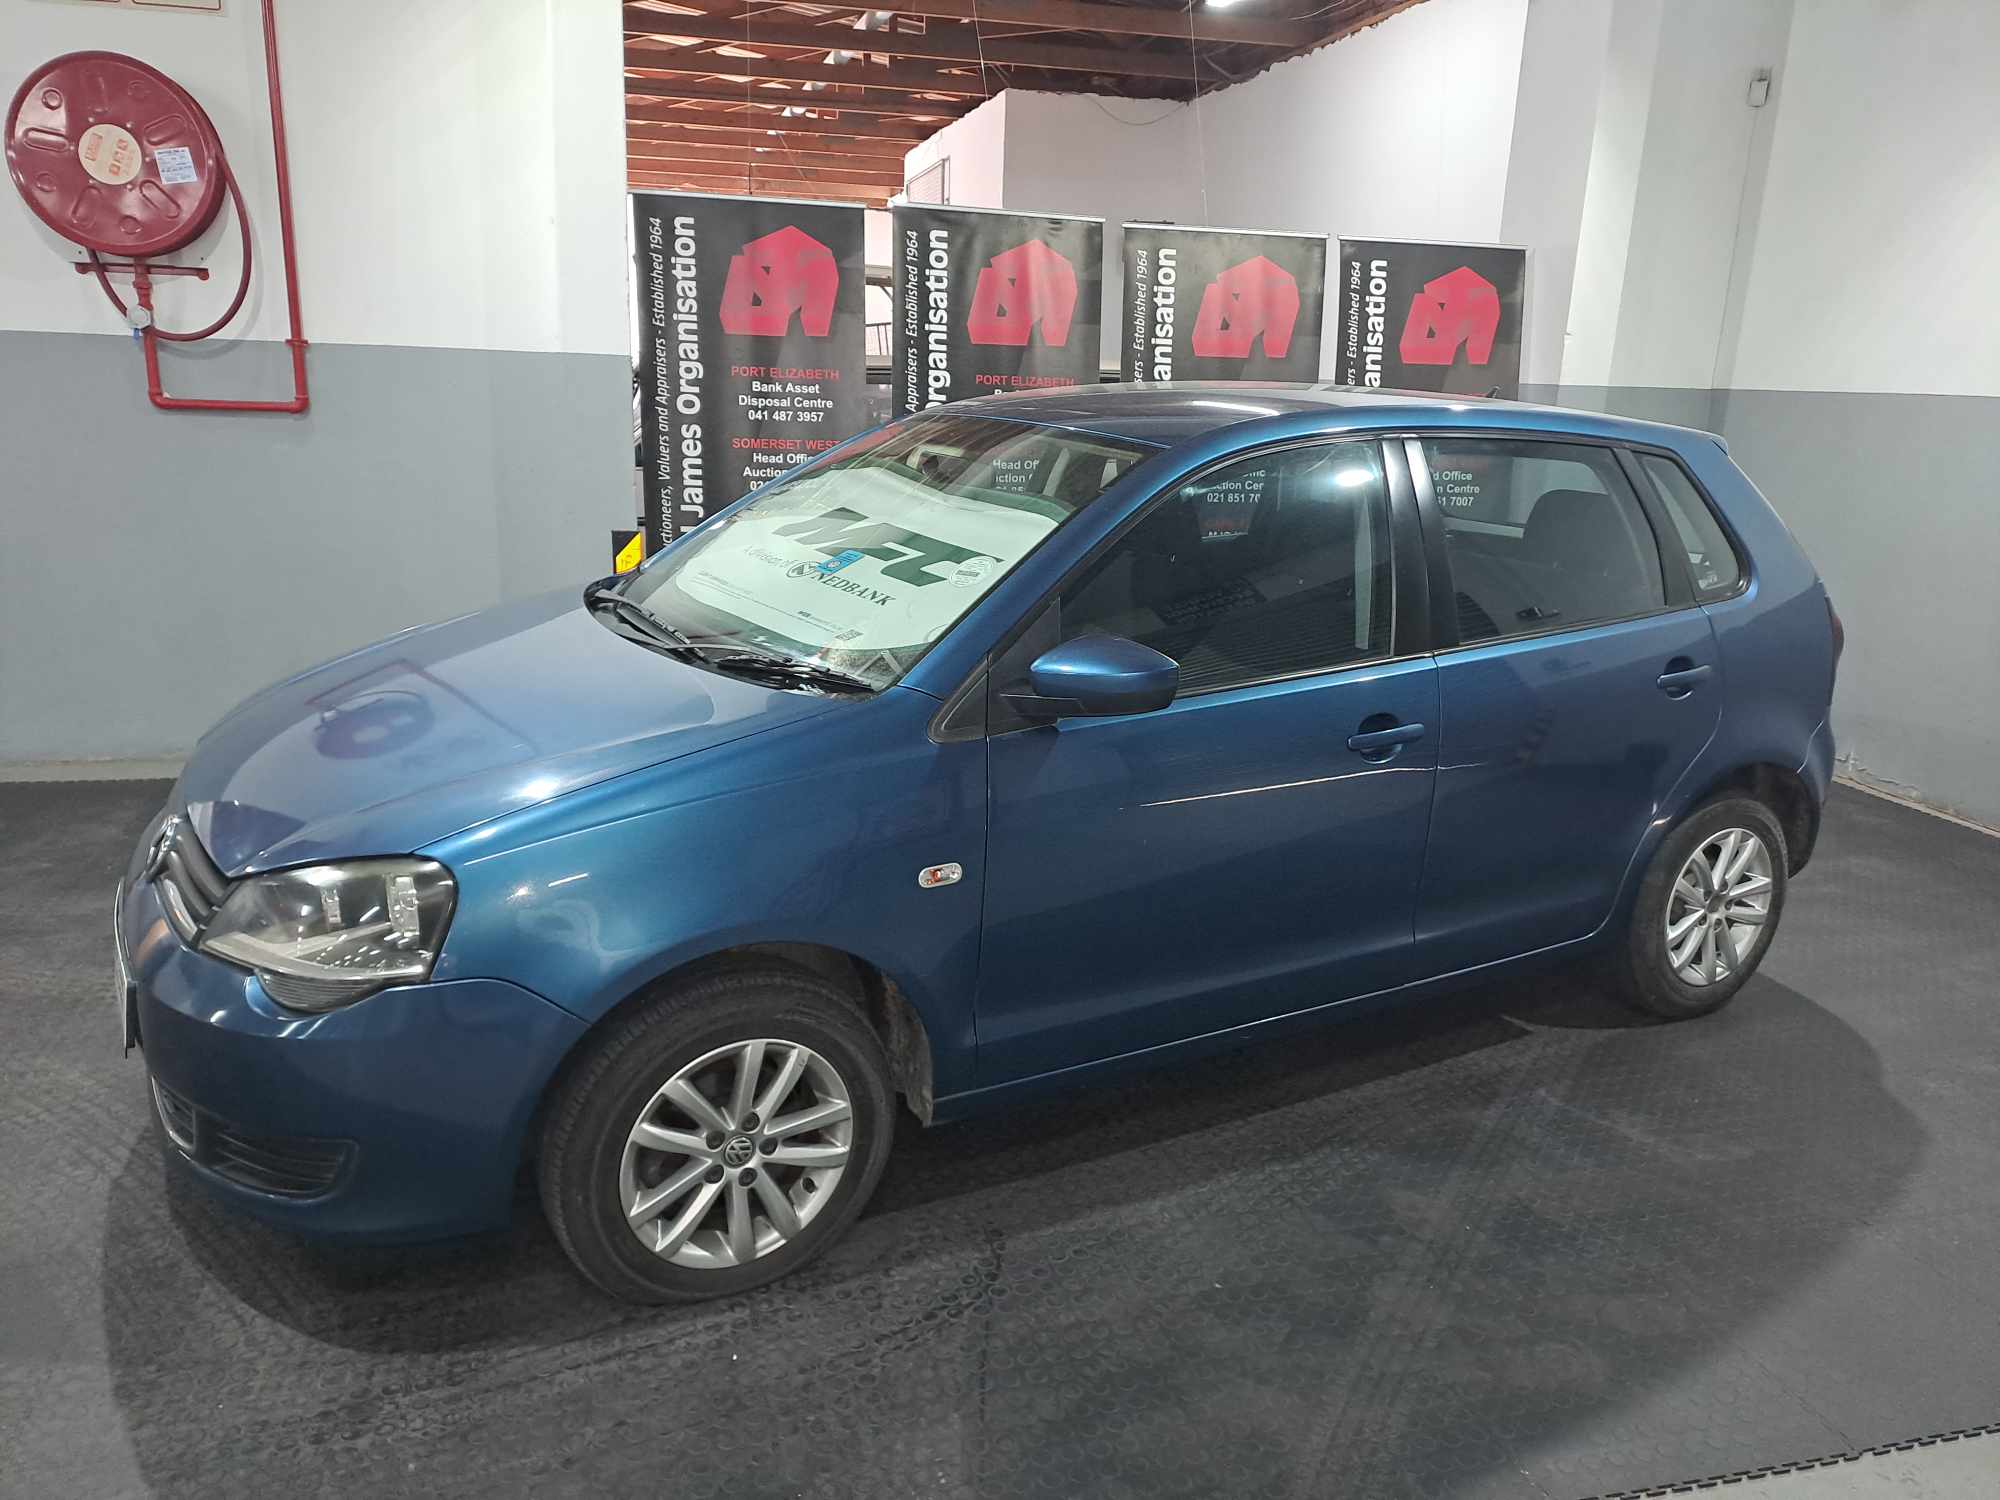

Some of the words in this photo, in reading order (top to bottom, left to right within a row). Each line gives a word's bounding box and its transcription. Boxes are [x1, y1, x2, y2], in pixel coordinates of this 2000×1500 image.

[648, 217, 663, 249] 1964
[906, 230, 919, 262] 1964
[1136, 249, 1148, 279] 1964
[1350, 261, 1361, 290] 1964
[649, 252, 665, 327] Established
[905, 264, 919, 338] Established
[670, 216, 704, 415] Organisation
[1132, 282, 1147, 351] Established
[1346, 292, 1360, 359] Established
[653, 337, 670, 405] Appraisers
[731, 366, 766, 377] PORT
[769, 367, 840, 379] ELIZABETH
[904, 347, 920, 412] Appraisers
[975, 374, 1008, 385] PORT
[738, 395, 791, 409] Disposal
[794, 397, 834, 409] Centre
[752, 381, 783, 393] Bank
[785, 382, 820, 394] Asset
[655, 407, 668, 432] and
[748, 409, 769, 421] 041
[772, 410, 793, 421] 487
[797, 411, 824, 423] 3957
[657, 436, 671, 480] Valuers
[732, 438, 803, 450] SOMERSET
[753, 452, 784, 464] Head
[680, 423, 704, 519] James
[1442, 471, 1473, 481] Office
[1207, 493, 1224, 503] 021
[1227, 493, 1245, 503] 851
[1446, 484, 1480, 494] Centre
[1450, 496, 1474, 506] 7007
[660, 486, 674, 546] ctioneers,
[809, 572, 897, 606] NEDBANK
